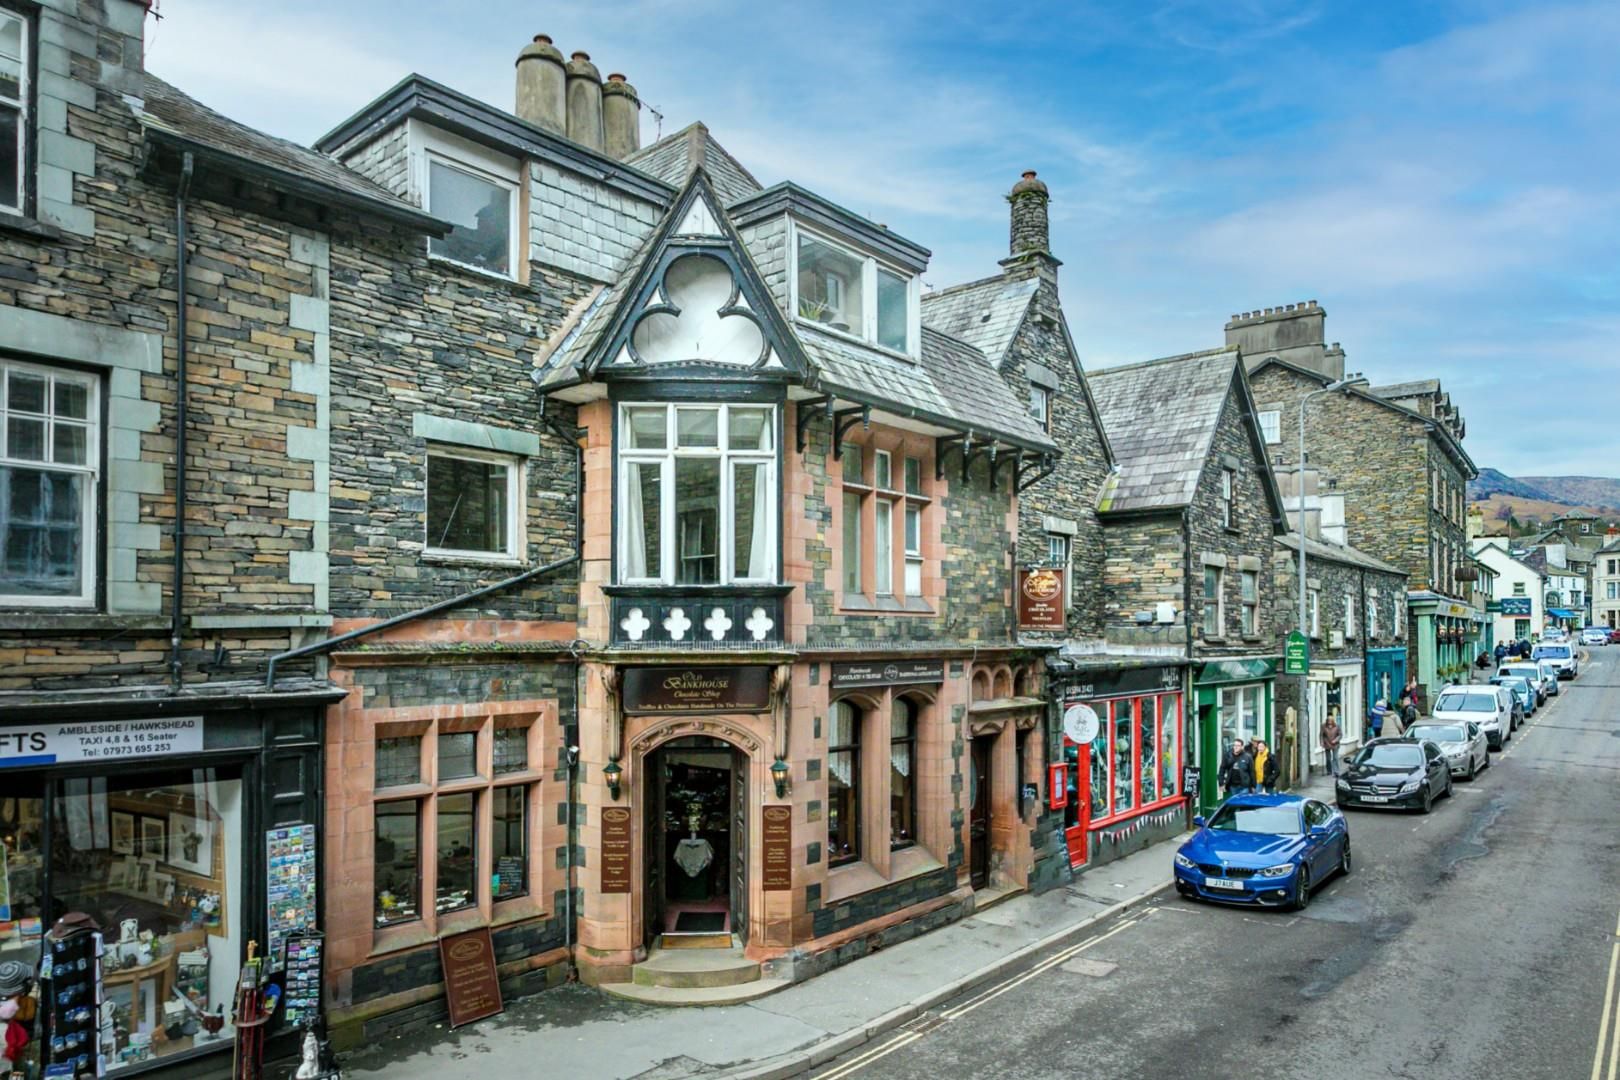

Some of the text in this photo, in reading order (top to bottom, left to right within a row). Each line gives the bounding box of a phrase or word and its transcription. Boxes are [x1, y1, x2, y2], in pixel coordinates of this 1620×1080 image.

[663, 677, 729, 689] BANKHOUSE
[58, 720, 195, 736] AMBLESIDE / HAWKSHEAD
[80, 736, 103, 746] TAXI
[123, 734, 131, 743] &
[134, 733, 145, 743] 16
[148, 732, 178, 742] Seater
[82, 743, 171, 757] Tel: 07973 695 253
